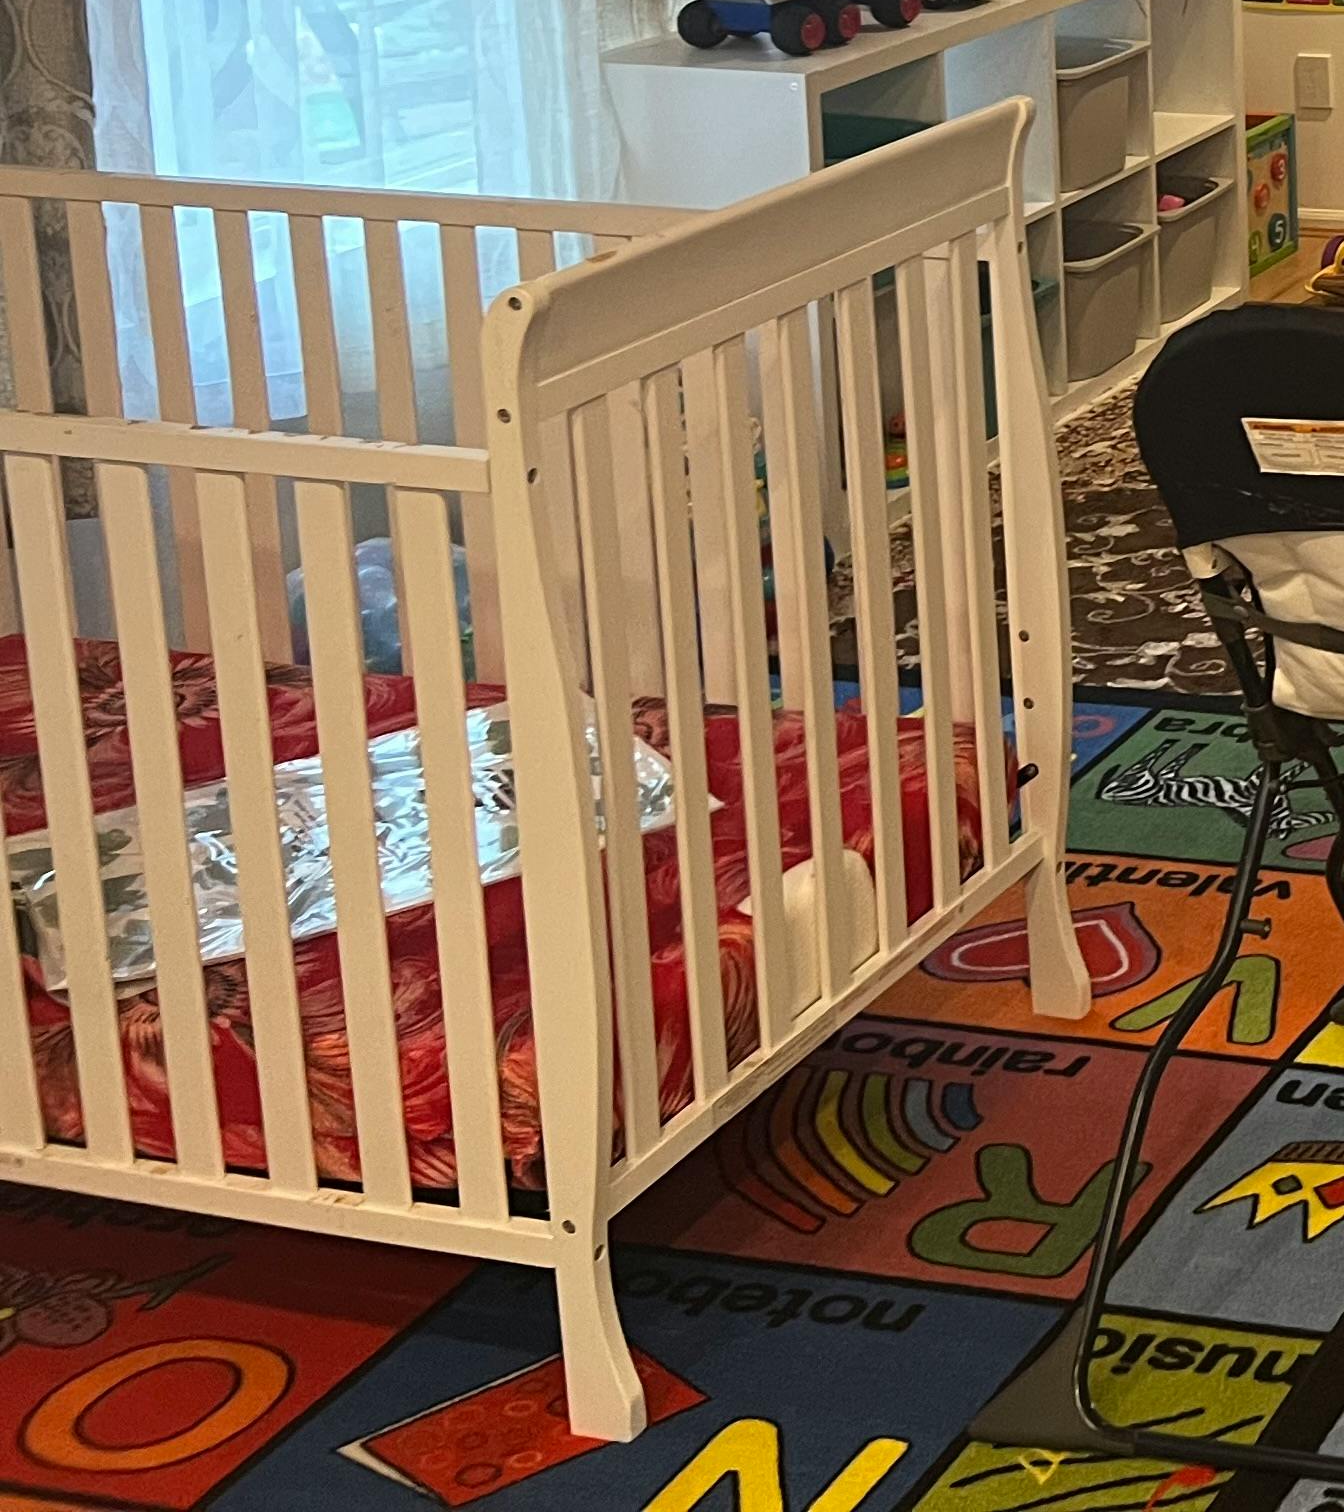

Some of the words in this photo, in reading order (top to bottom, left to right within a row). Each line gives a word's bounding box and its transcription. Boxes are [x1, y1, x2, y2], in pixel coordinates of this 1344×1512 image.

[1274, 219, 1285, 244] 5
[822, 1031, 1091, 1079] rainbo
[907, 1142, 1152, 1278] R
[618, 1270, 927, 1334] notebo
[19, 1335, 296, 1476] O
